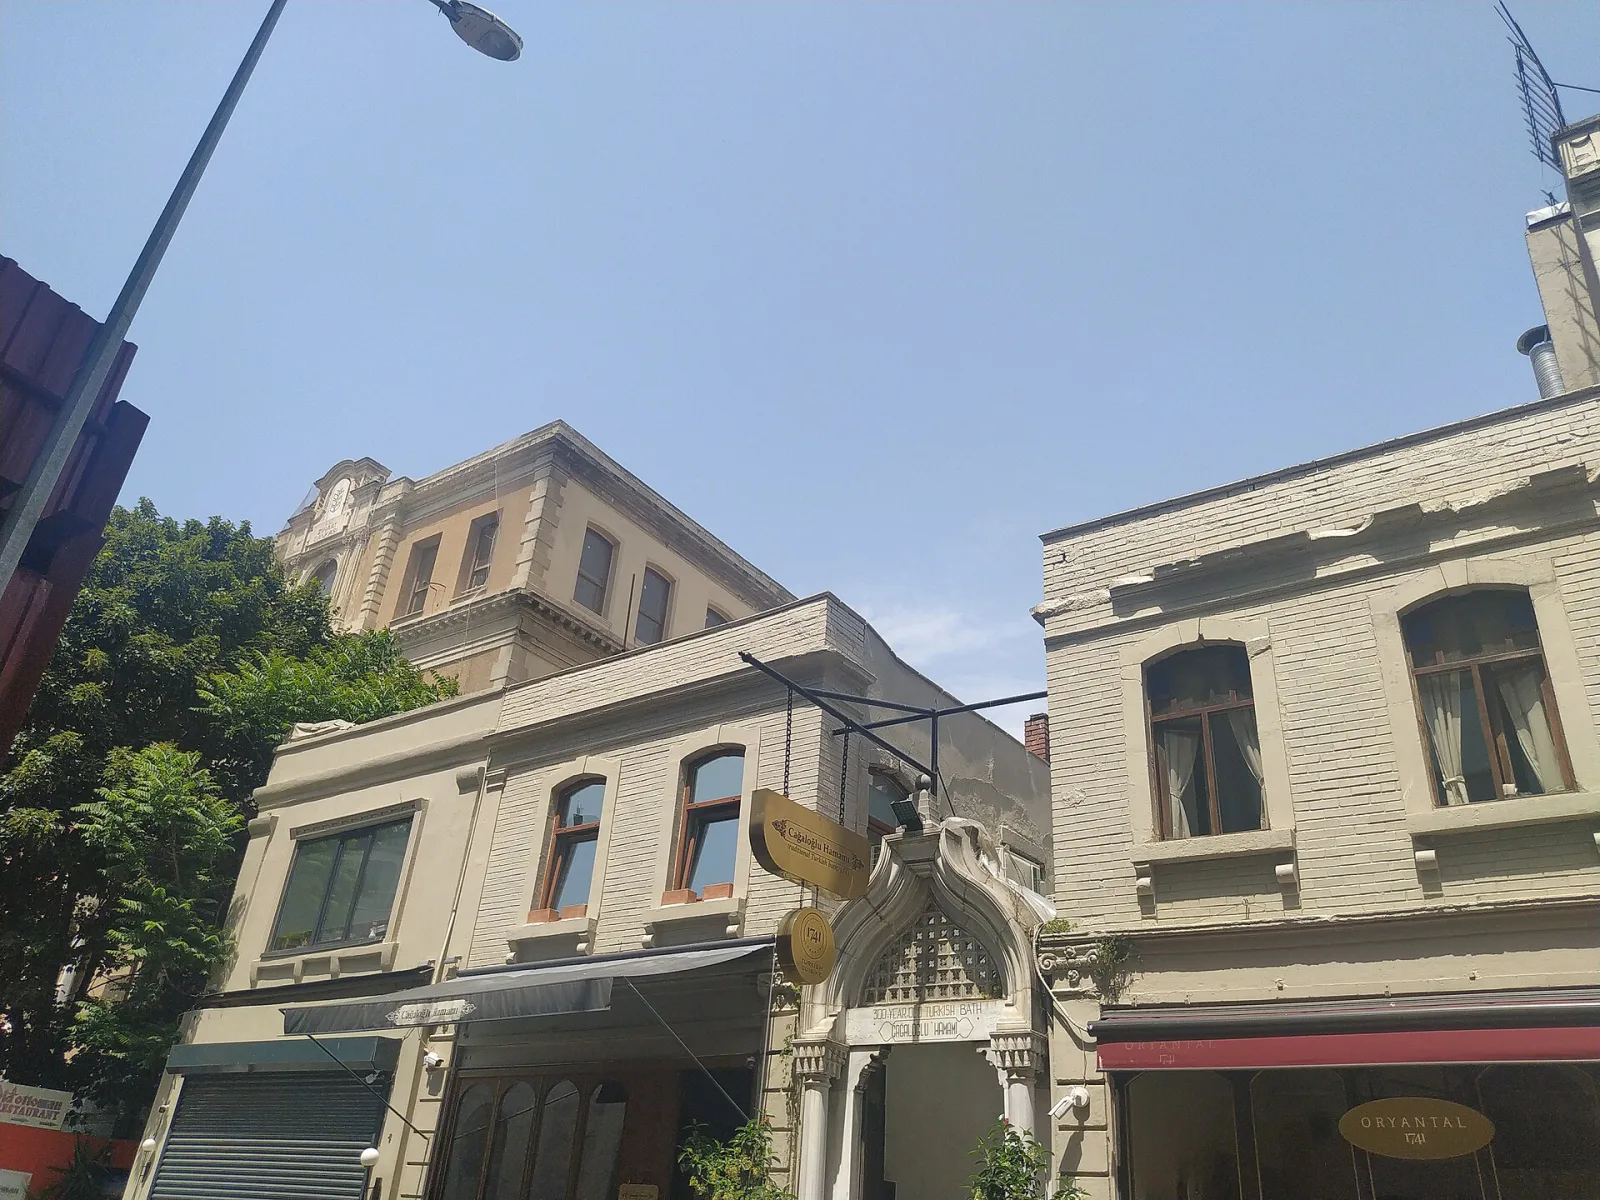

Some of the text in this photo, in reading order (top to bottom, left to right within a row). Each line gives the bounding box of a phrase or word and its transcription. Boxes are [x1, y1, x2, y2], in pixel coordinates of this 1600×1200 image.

[788, 827, 822, 850] Cağaloğlu
[807, 926, 822, 944] 1741
[925, 1004, 955, 1018] TURKISH
[959, 1002, 982, 1016] BATH
[933, 1021, 958, 1036] HAMAMI
[1124, 1039, 1217, 1051] ORYANTAL
[1360, 1116, 1467, 1129] ORYANTAL
[1404, 1132, 1427, 1146] 1741
